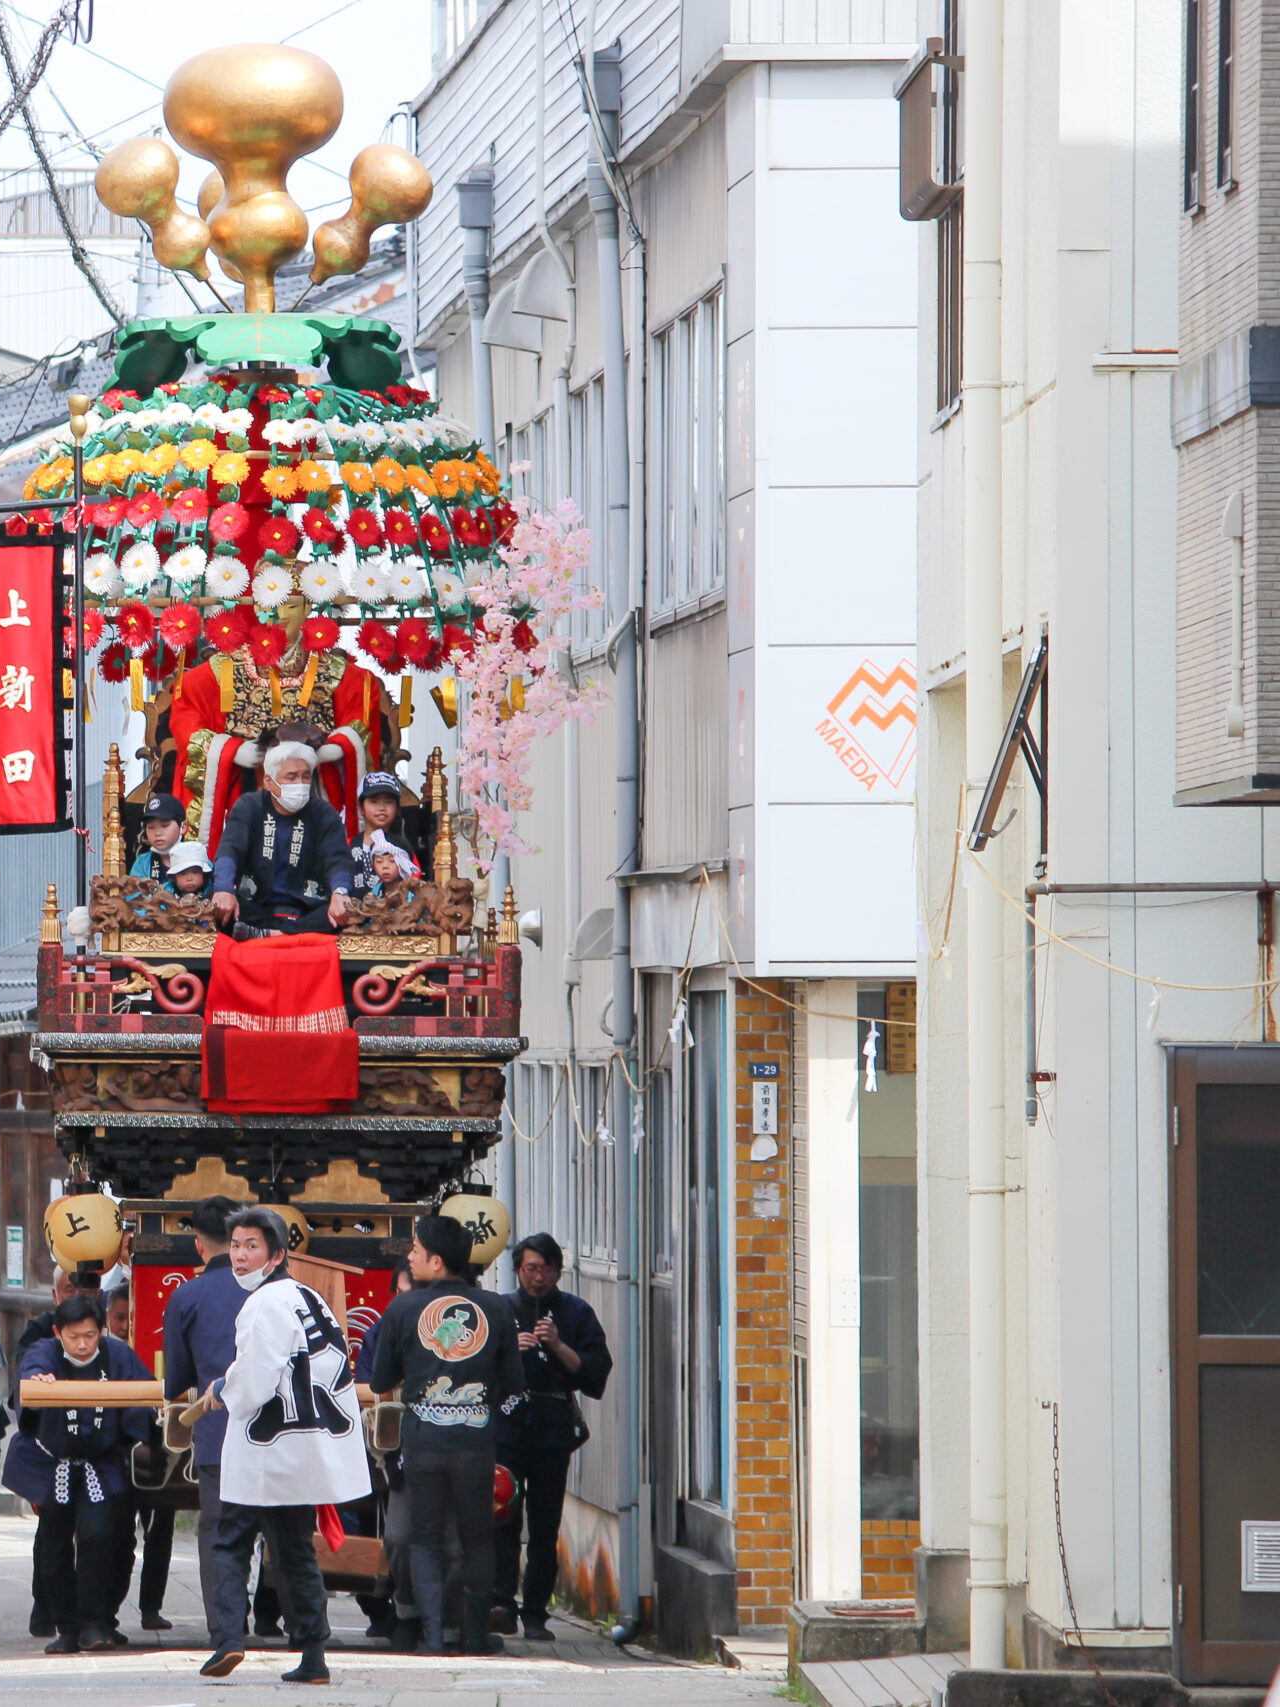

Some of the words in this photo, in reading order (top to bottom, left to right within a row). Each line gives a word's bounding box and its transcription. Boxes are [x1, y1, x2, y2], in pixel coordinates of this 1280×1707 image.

[814, 718, 879, 792] MAEDA
[262, 813, 277, 860] 上新田町
[289, 819, 305, 867] 上新田町
[753, 1065, 777, 1075] 1-29
[66, 1212, 90, 1238] 上
